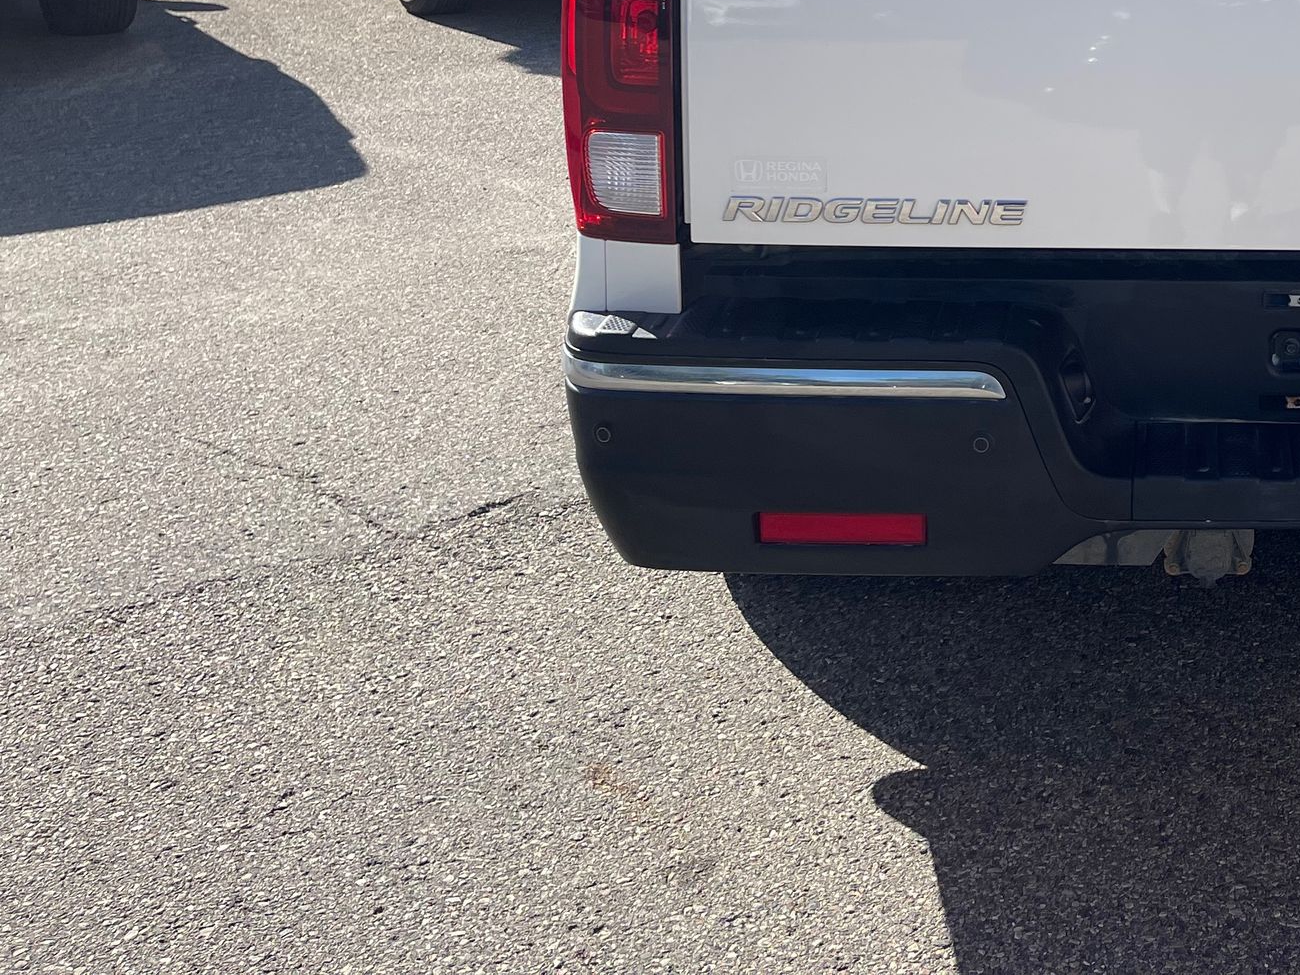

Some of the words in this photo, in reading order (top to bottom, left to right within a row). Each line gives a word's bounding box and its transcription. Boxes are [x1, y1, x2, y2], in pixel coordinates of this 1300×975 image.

[766, 161, 821, 171] REGINA
[766, 171, 818, 182] HONDA
[722, 196, 1029, 225] RIDGELINE
